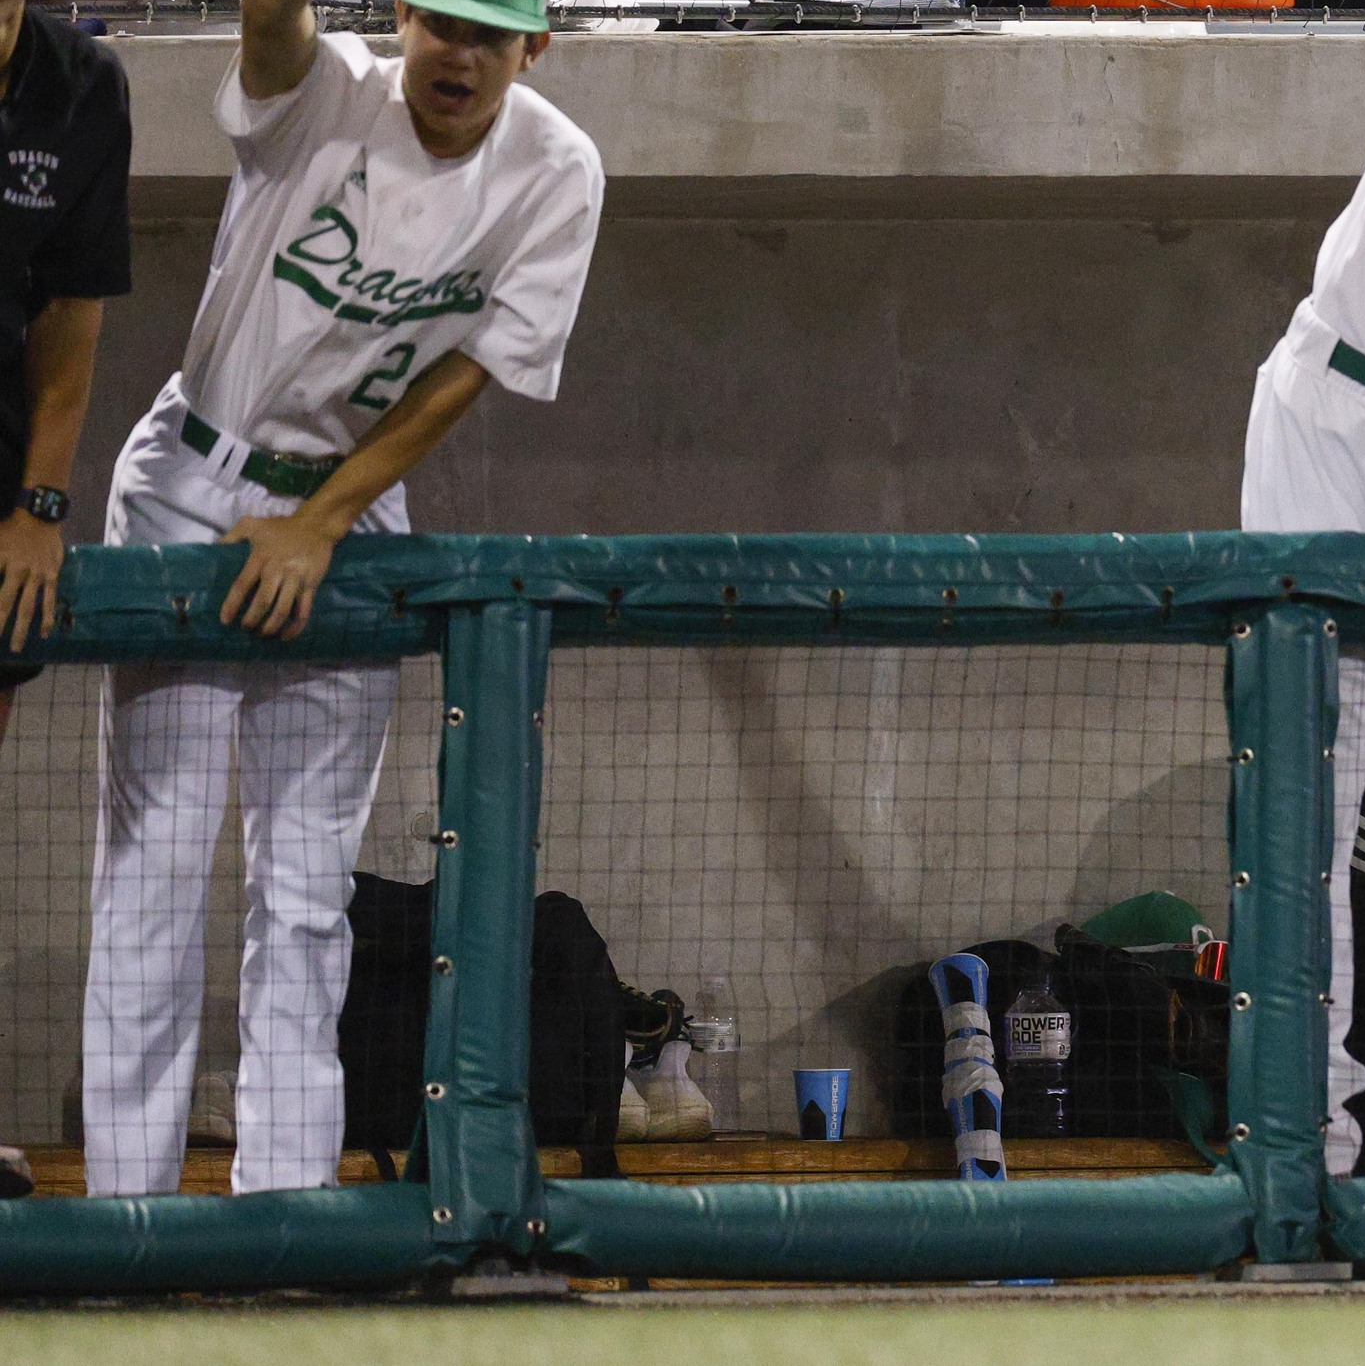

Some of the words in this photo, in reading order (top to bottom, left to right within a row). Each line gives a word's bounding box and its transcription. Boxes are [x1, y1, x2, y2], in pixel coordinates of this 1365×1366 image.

[7, 149, 60, 171] DRAGON
[348, 342, 417, 410] 2
[1011, 1017, 1065, 1031] POWER
[1010, 1031, 1042, 1045] ADE
[829, 1076, 840, 1138] POWERADE
